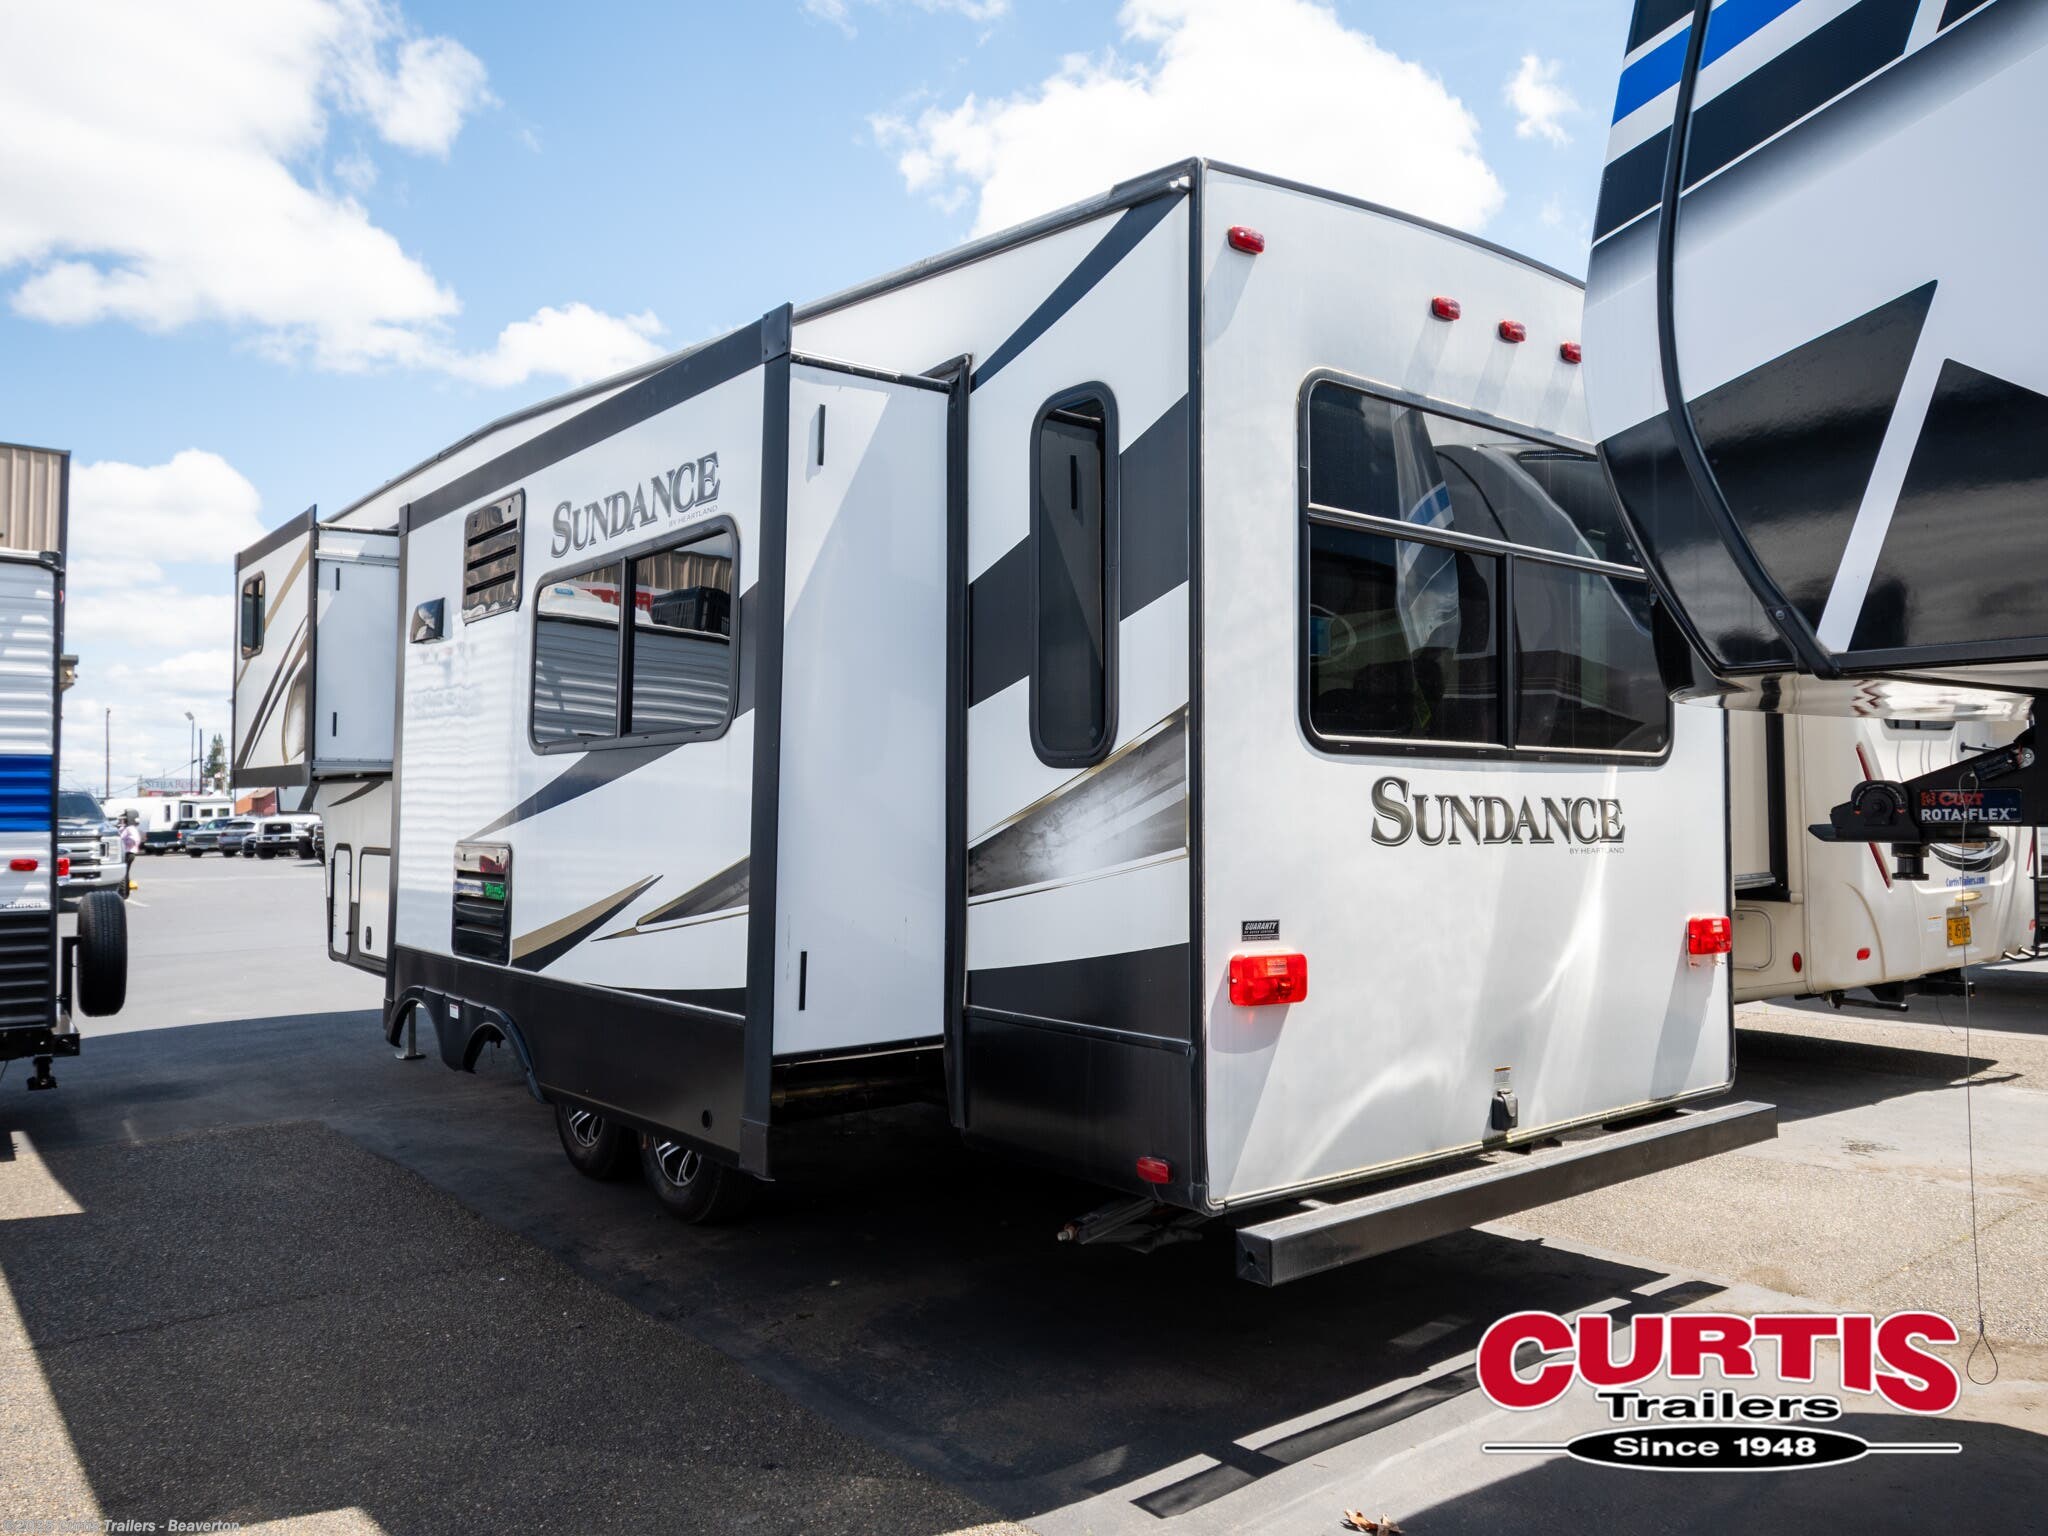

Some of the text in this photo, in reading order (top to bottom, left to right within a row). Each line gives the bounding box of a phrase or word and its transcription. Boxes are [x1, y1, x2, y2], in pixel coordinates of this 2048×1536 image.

[551, 451, 721, 558] SUNDANCE
[678, 504, 718, 523] HEARTLAND
[1371, 776, 1626, 847] SUNDANCE
[1569, 847, 1579, 855] BY
[1245, 922, 1277, 930] GUARANTY
